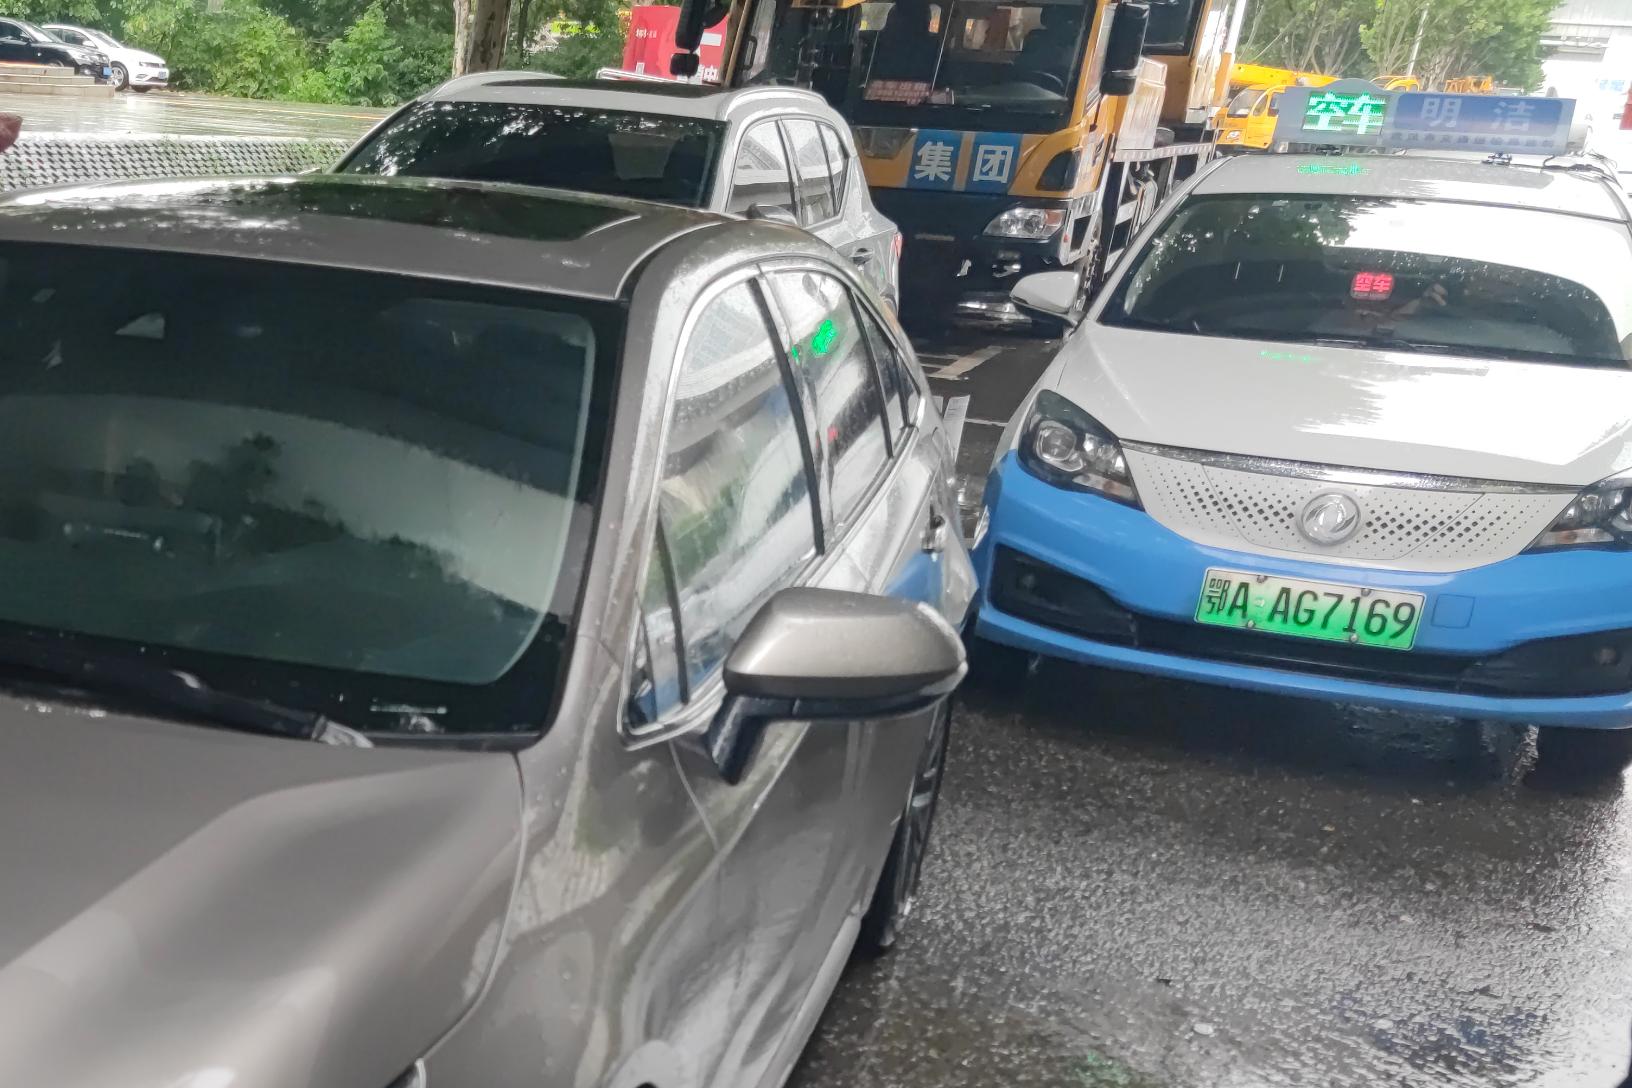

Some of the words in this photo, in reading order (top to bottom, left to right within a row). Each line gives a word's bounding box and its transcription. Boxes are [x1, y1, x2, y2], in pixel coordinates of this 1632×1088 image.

[1303, 91, 1386, 135] 空车
[1421, 97, 1535, 132] 明洁
[913, 141, 1015, 184] 集团
